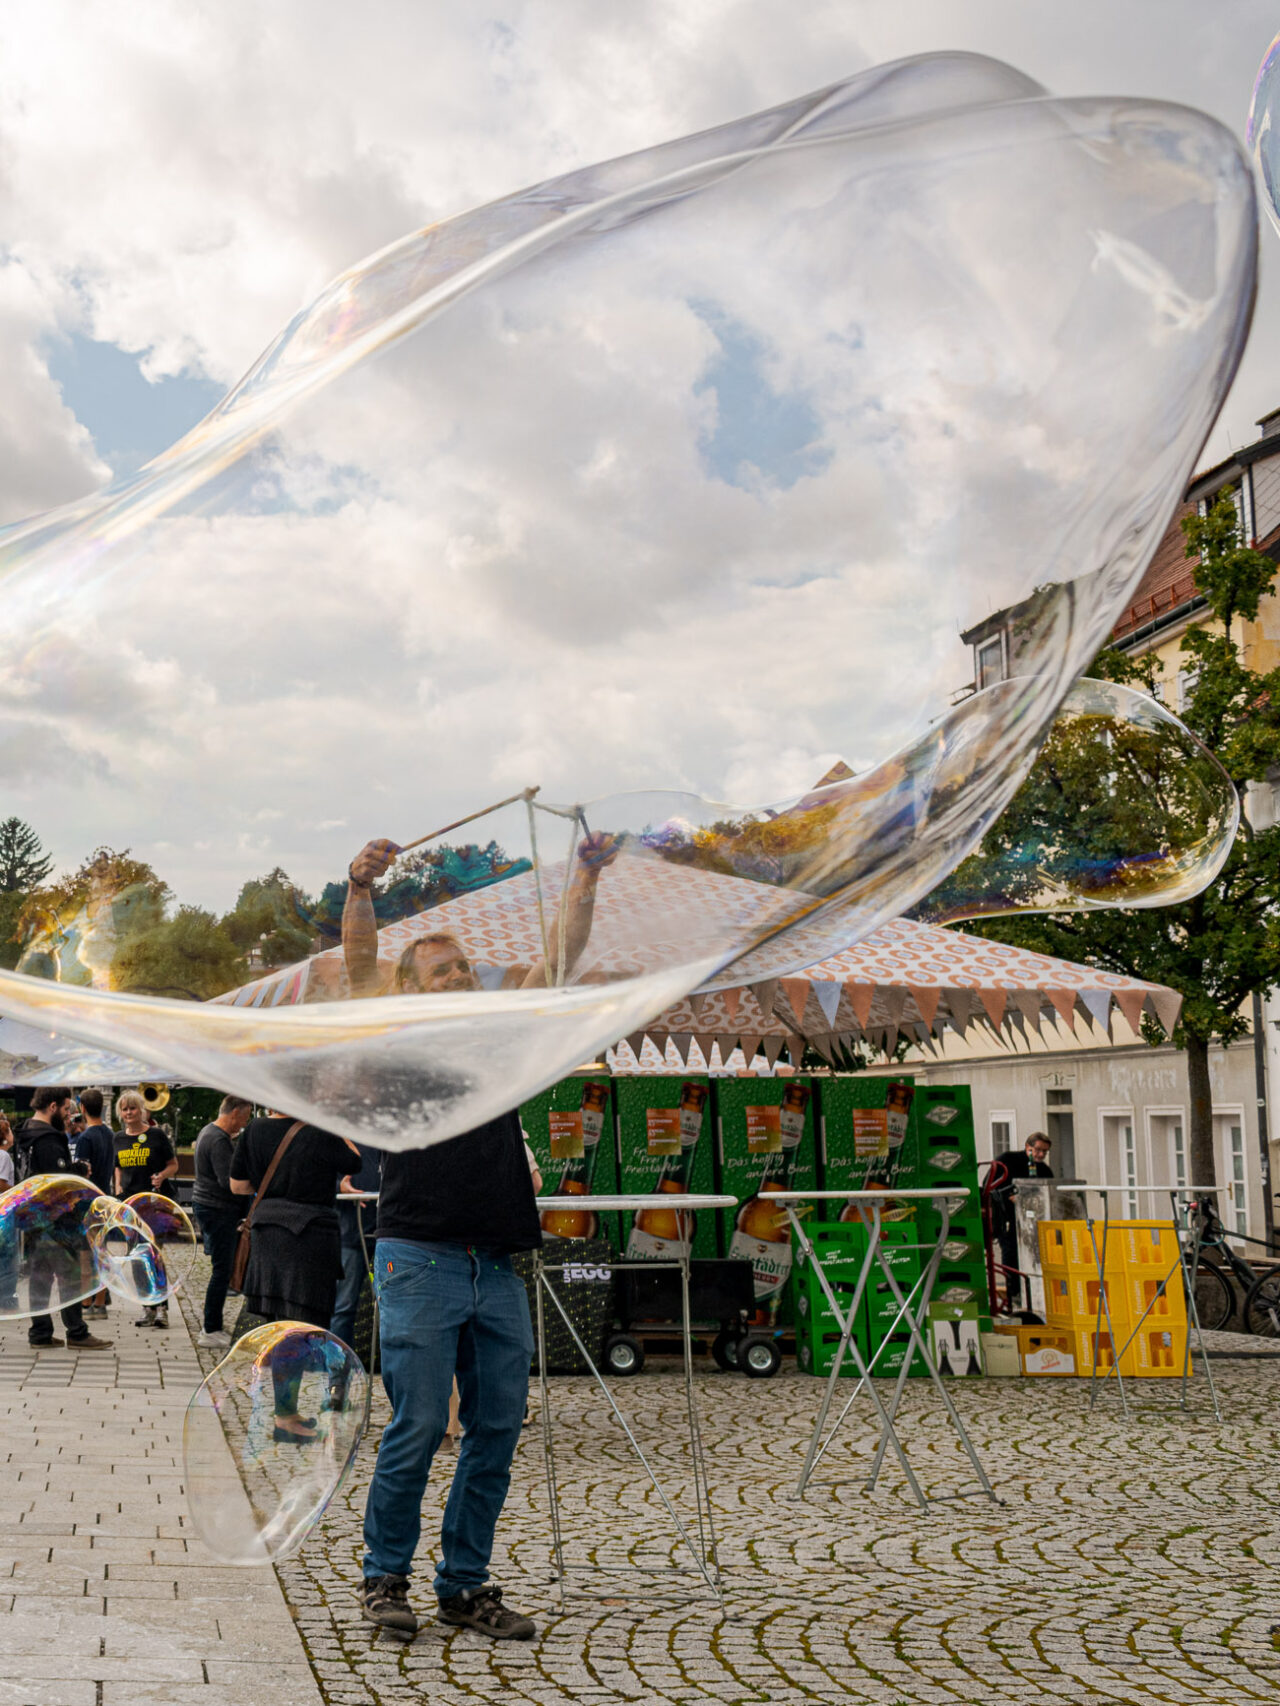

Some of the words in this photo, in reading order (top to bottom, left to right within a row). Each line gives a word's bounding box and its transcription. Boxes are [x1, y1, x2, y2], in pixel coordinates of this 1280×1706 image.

[137, 1156, 148, 1166] LEE
[640, 1155, 660, 1165] Frei
[727, 1158, 748, 1169] Das
[830, 1158, 851, 1169] Das
[745, 1168, 784, 1179] andere
[848, 1168, 887, 1179] andere
[570, 1262, 613, 1281] EGG
